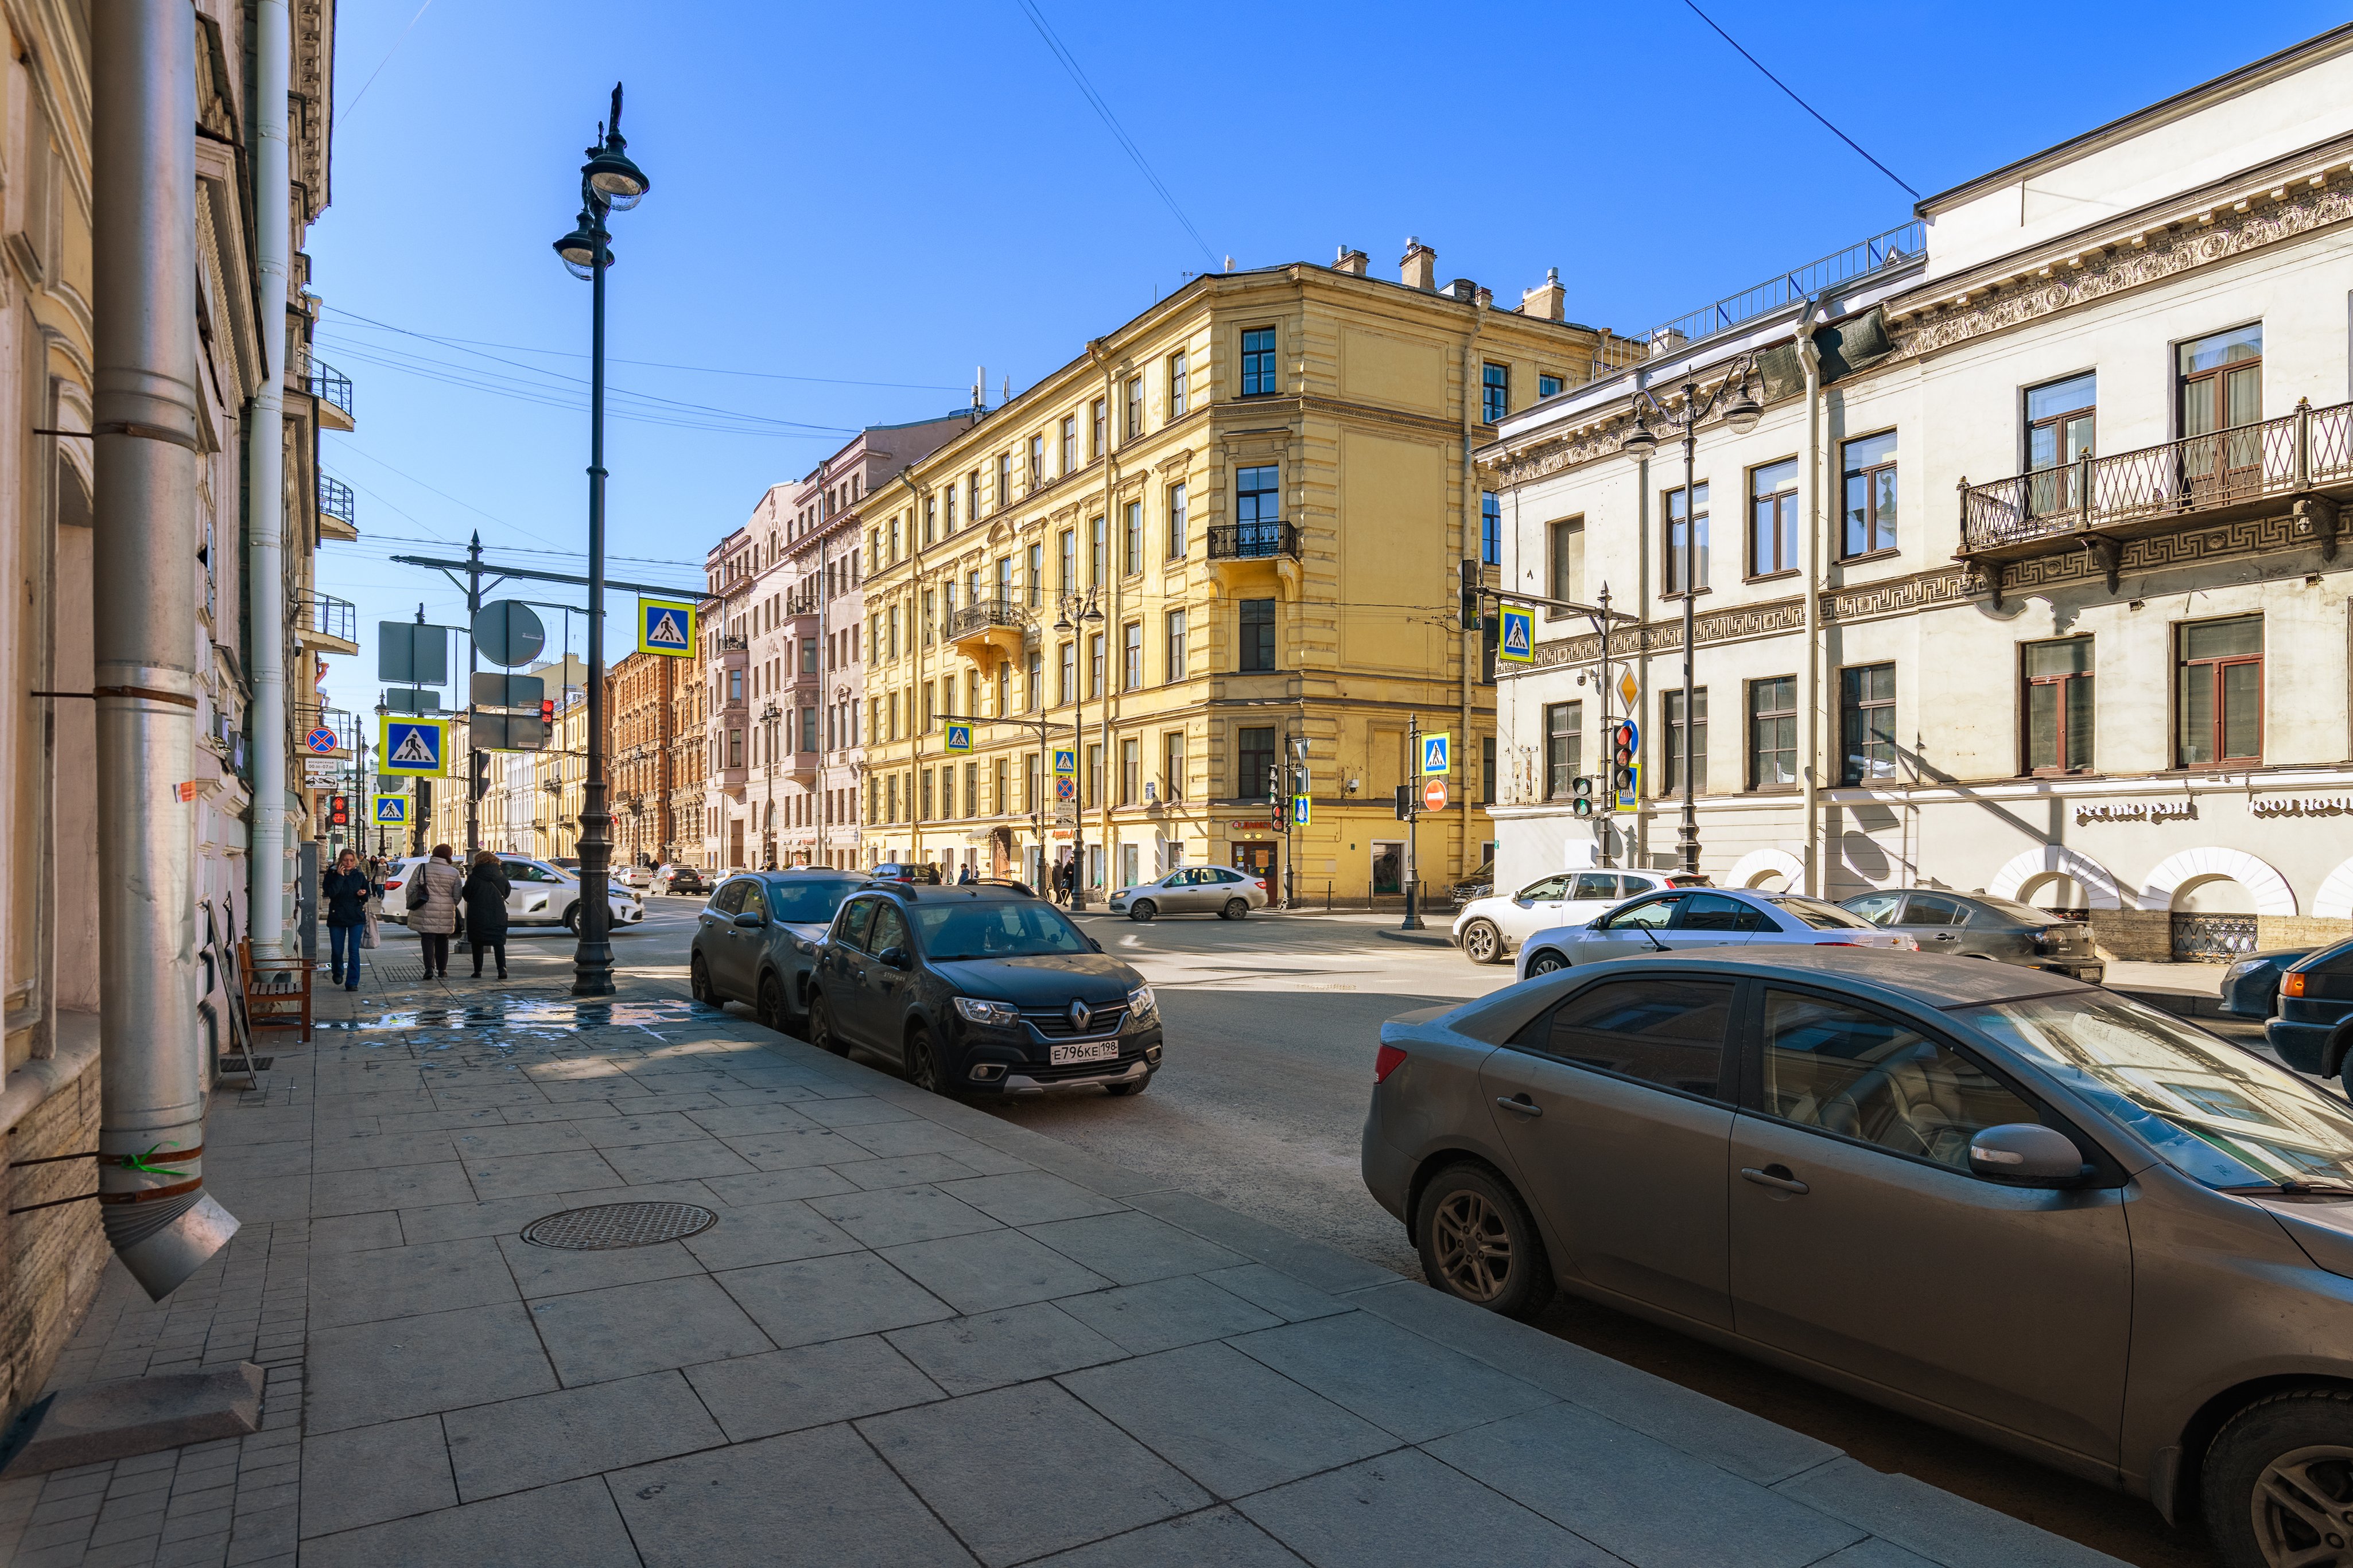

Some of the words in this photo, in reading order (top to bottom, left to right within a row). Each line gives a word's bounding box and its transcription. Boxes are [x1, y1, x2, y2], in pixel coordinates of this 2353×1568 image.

[2299, 796, 2353, 812] ноч
[2072, 802, 2191, 822] ресторан
[884, 972, 906, 982] STEPWAY
[1100, 1041, 1116, 1052] 198
